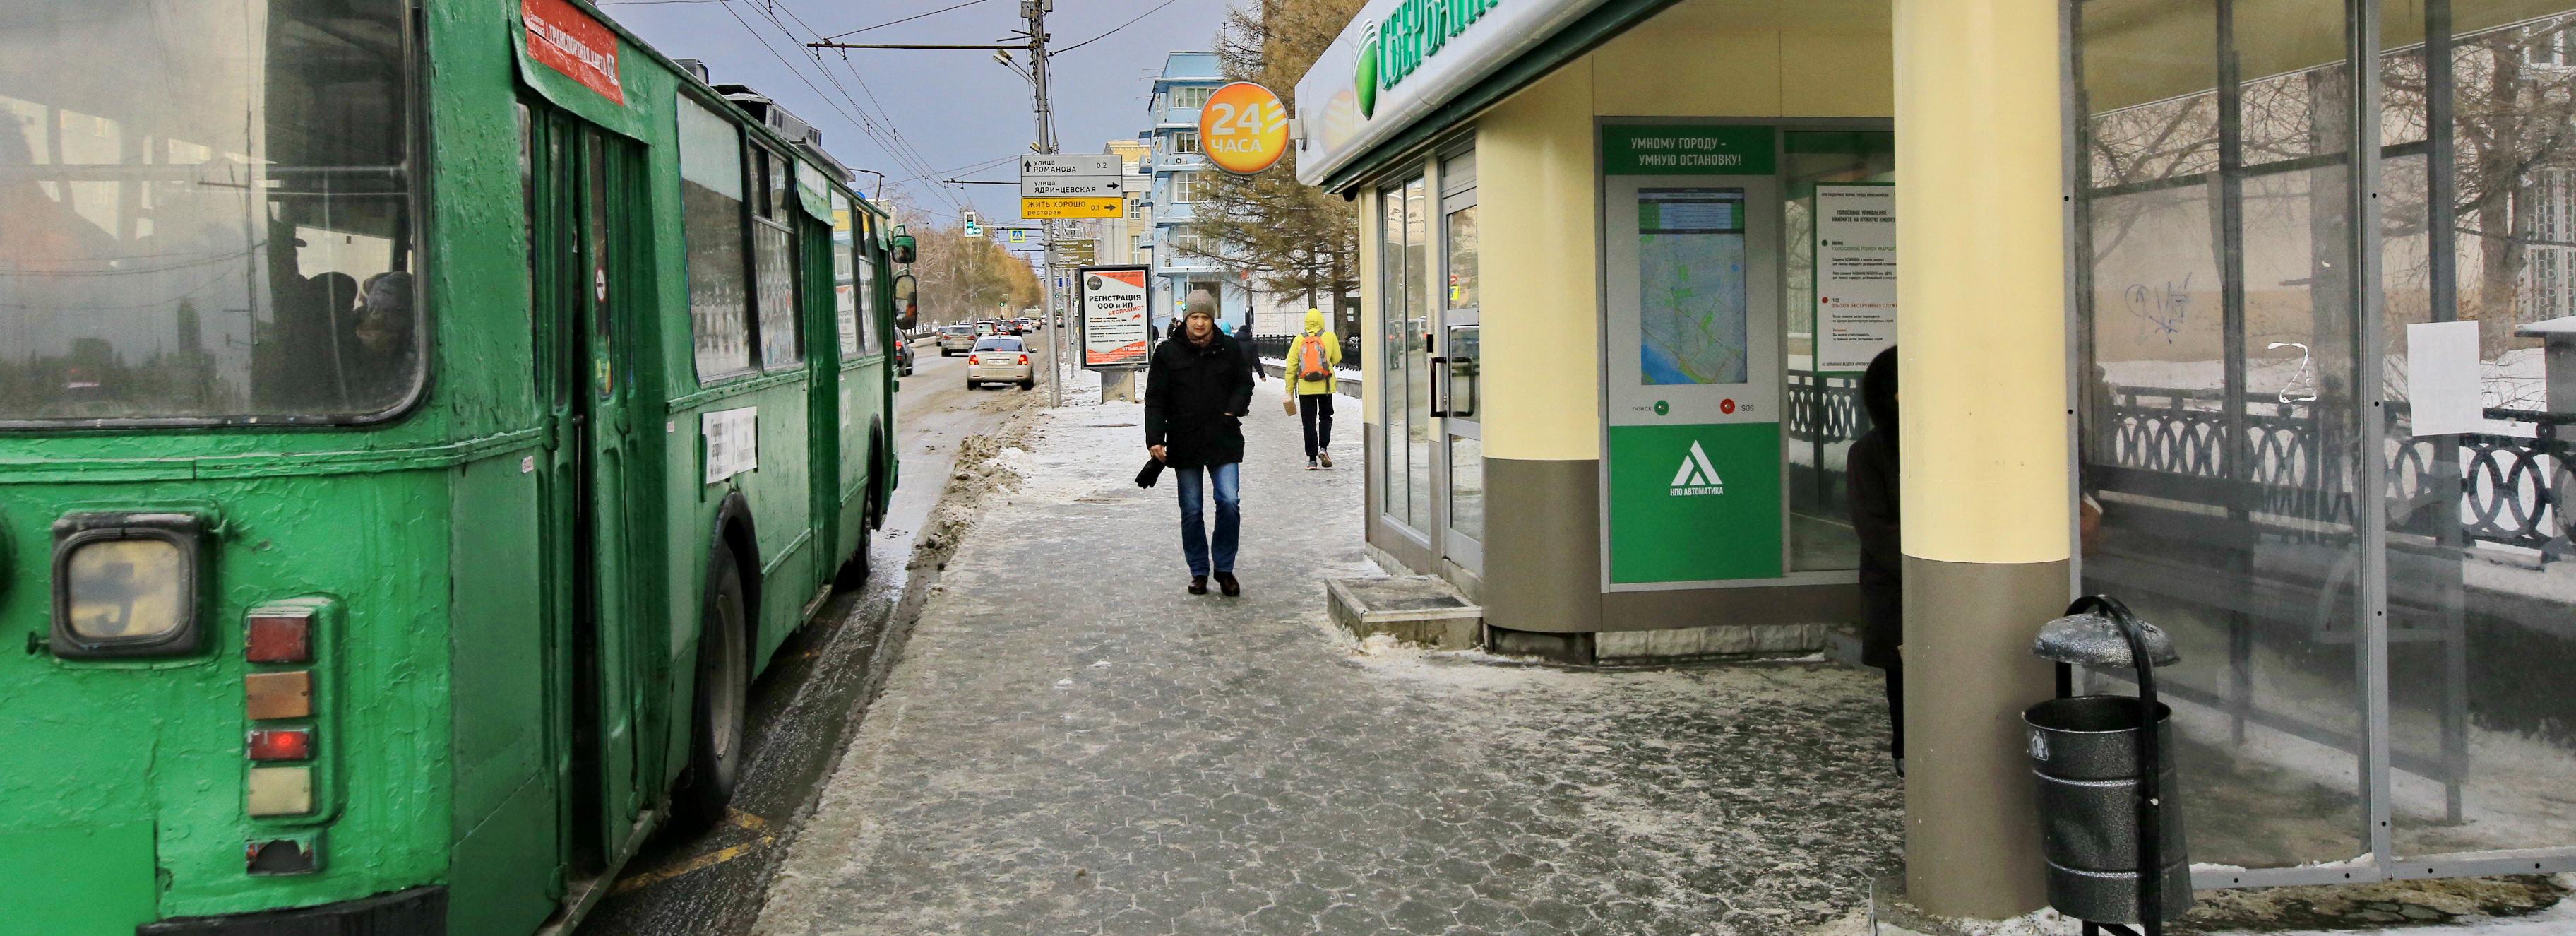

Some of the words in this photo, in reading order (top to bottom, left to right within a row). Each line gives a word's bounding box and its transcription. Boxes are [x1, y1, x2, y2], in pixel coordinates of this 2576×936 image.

[1379, 0, 1498, 90] СБЕРБА
[1211, 102, 1263, 135] 24
[1211, 138, 1263, 153] ЧАСА
[1630, 138, 1676, 150] УМНОМУ
[1678, 138, 1718, 151] ГОРОДУ
[1638, 154, 1676, 165] УМНУЮ
[1680, 154, 1742, 165] ОСТАНОВКУ!
[1683, 487, 1724, 496] АВТОМАТИКА
